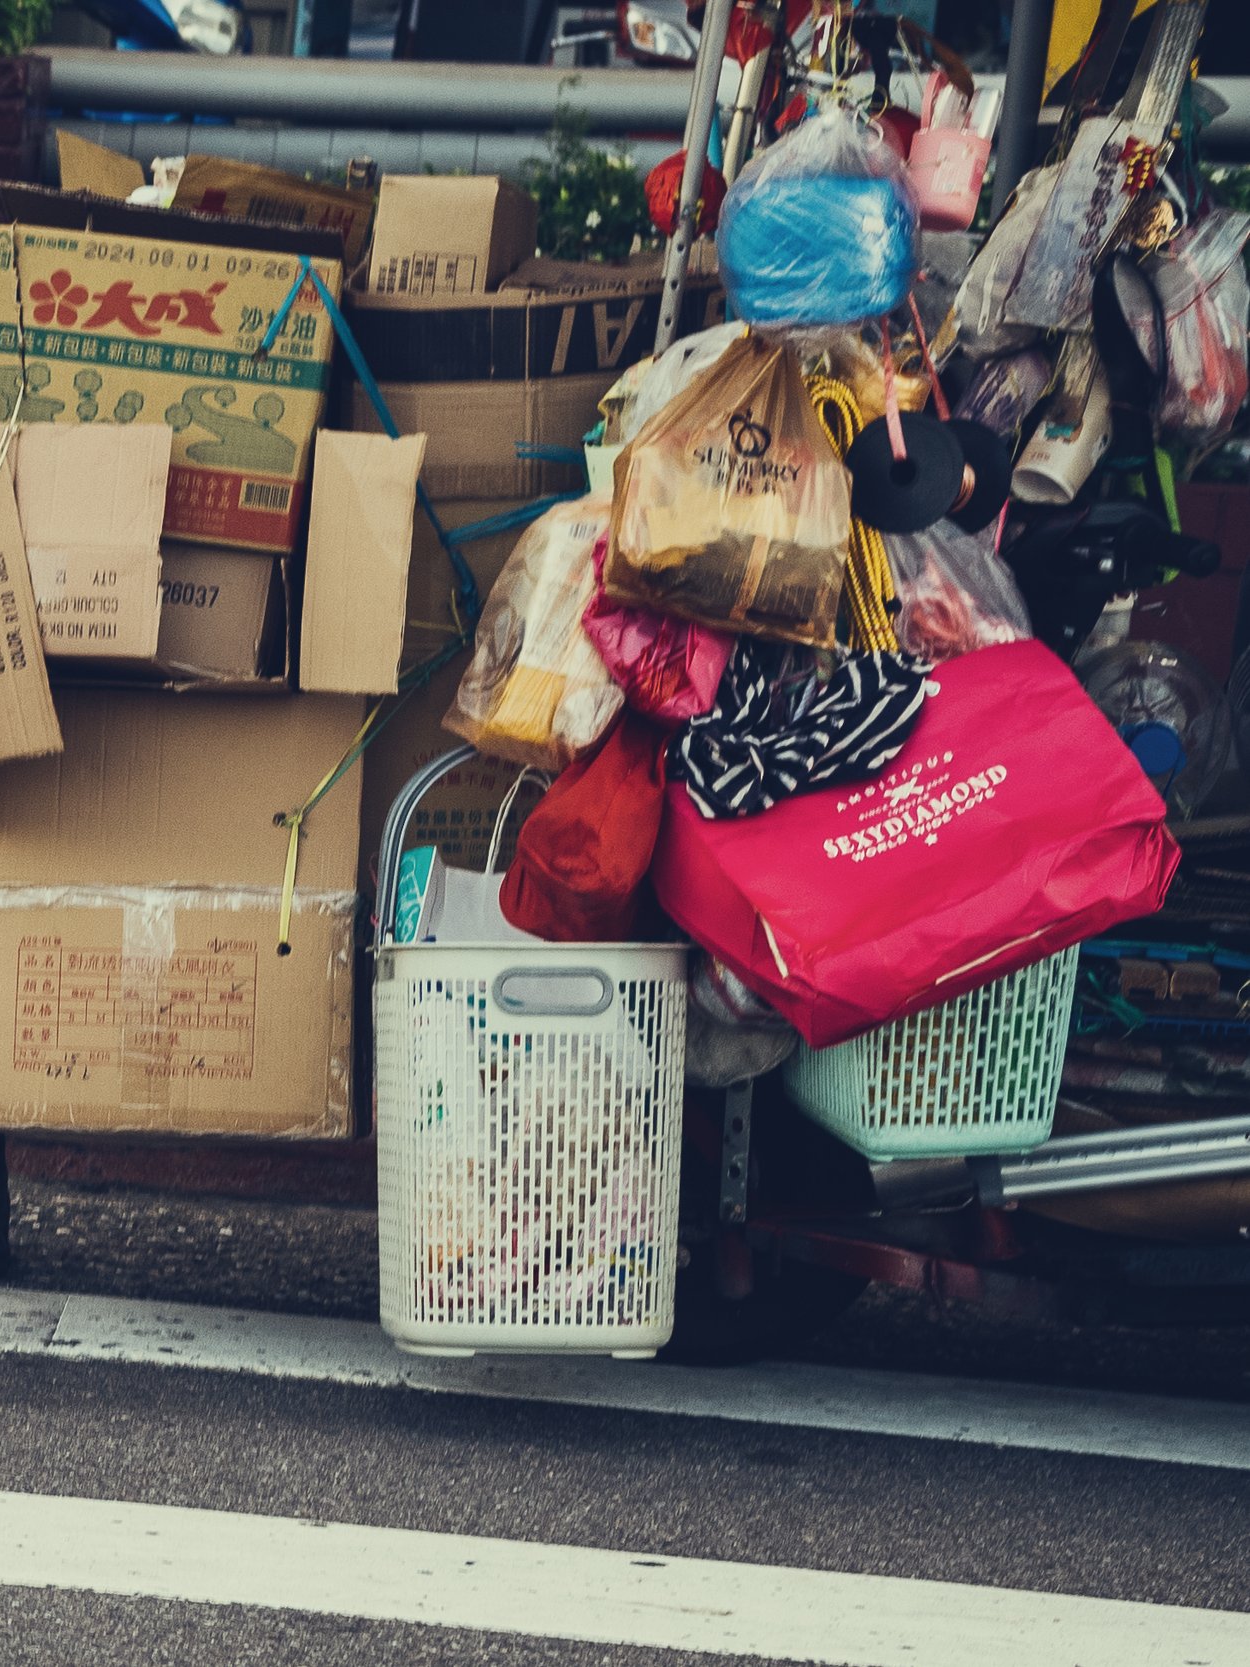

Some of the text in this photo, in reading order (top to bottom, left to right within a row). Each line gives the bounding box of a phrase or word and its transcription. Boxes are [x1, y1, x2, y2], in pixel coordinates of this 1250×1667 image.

[84, 240, 291, 280] 2024.08.01 09:26
[823, 764, 1008, 859] SEXYDIAMOND
[851, 787, 996, 863] WORLD WIDE LOVE
